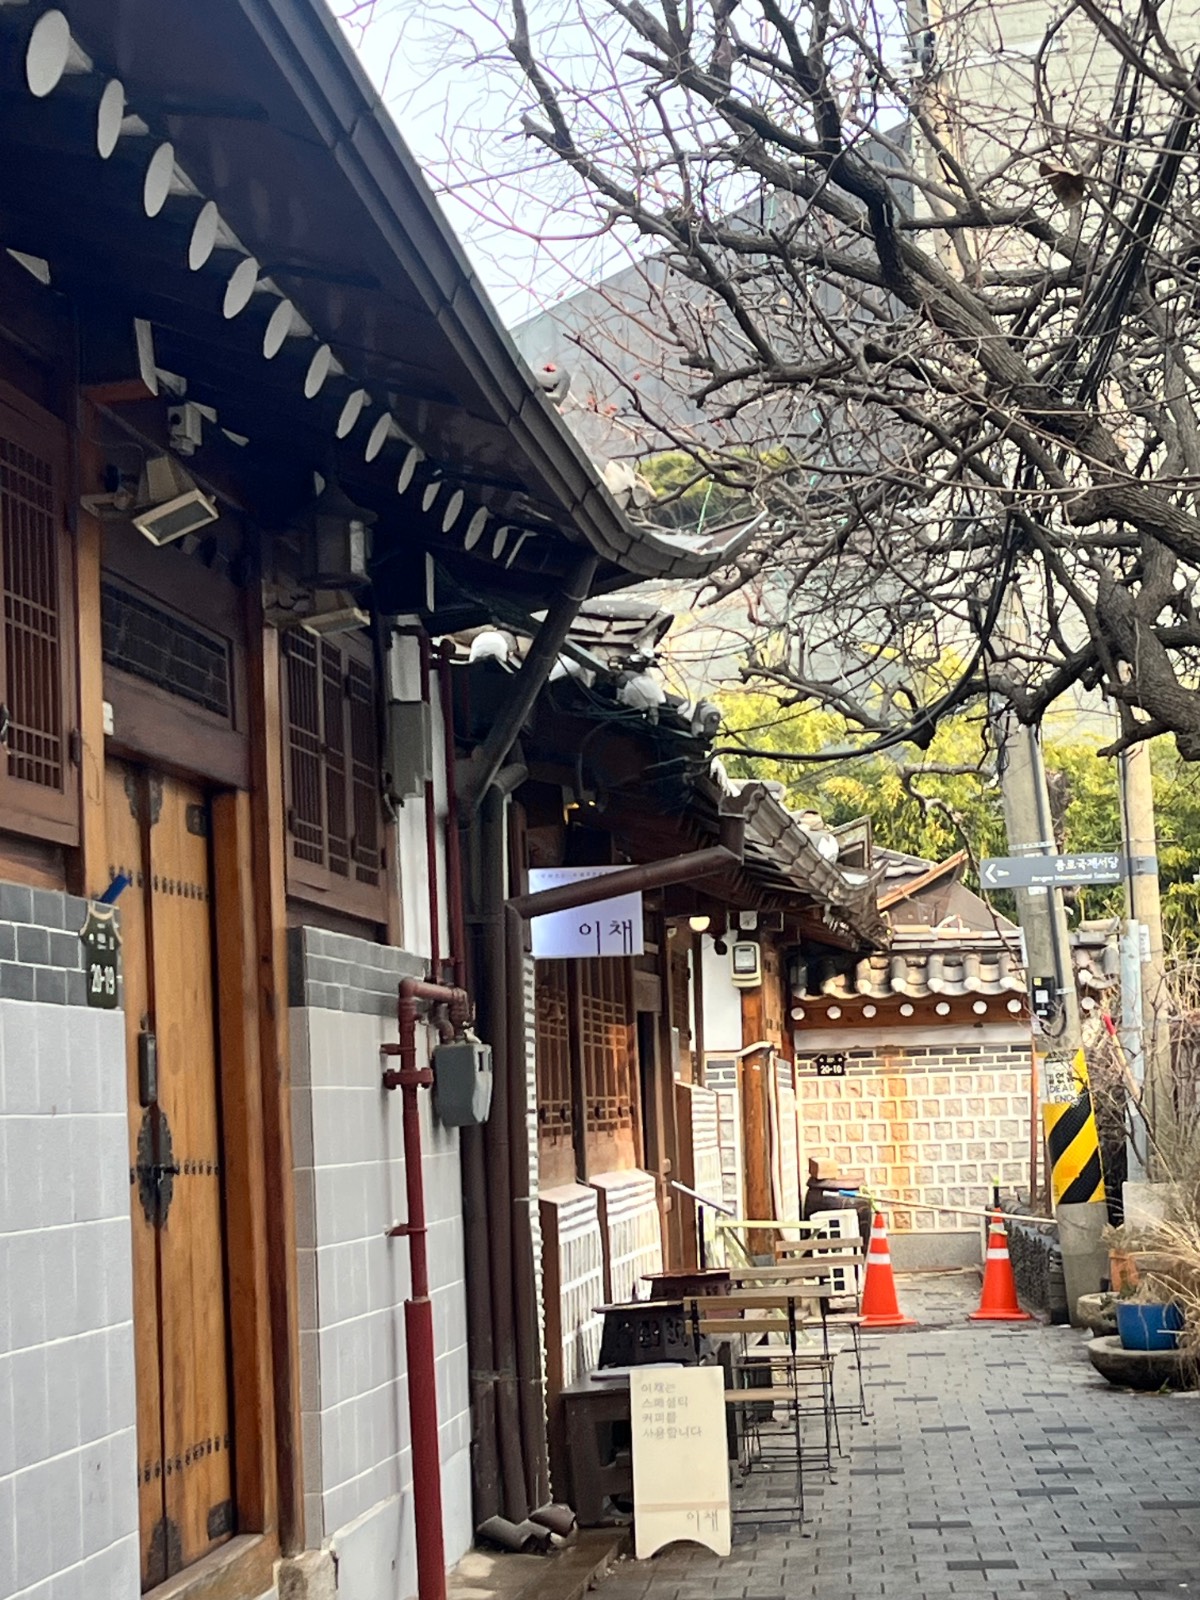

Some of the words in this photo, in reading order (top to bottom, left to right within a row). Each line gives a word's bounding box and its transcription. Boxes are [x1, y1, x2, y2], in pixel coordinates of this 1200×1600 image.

[90, 963, 115, 995] 20-19
[1049, 1083, 1075, 1093] DEAD
[1054, 1093, 1074, 1103] END
[642, 1412, 676, 1424] 커피를
[642, 1426, 702, 1439] 사용합니다
